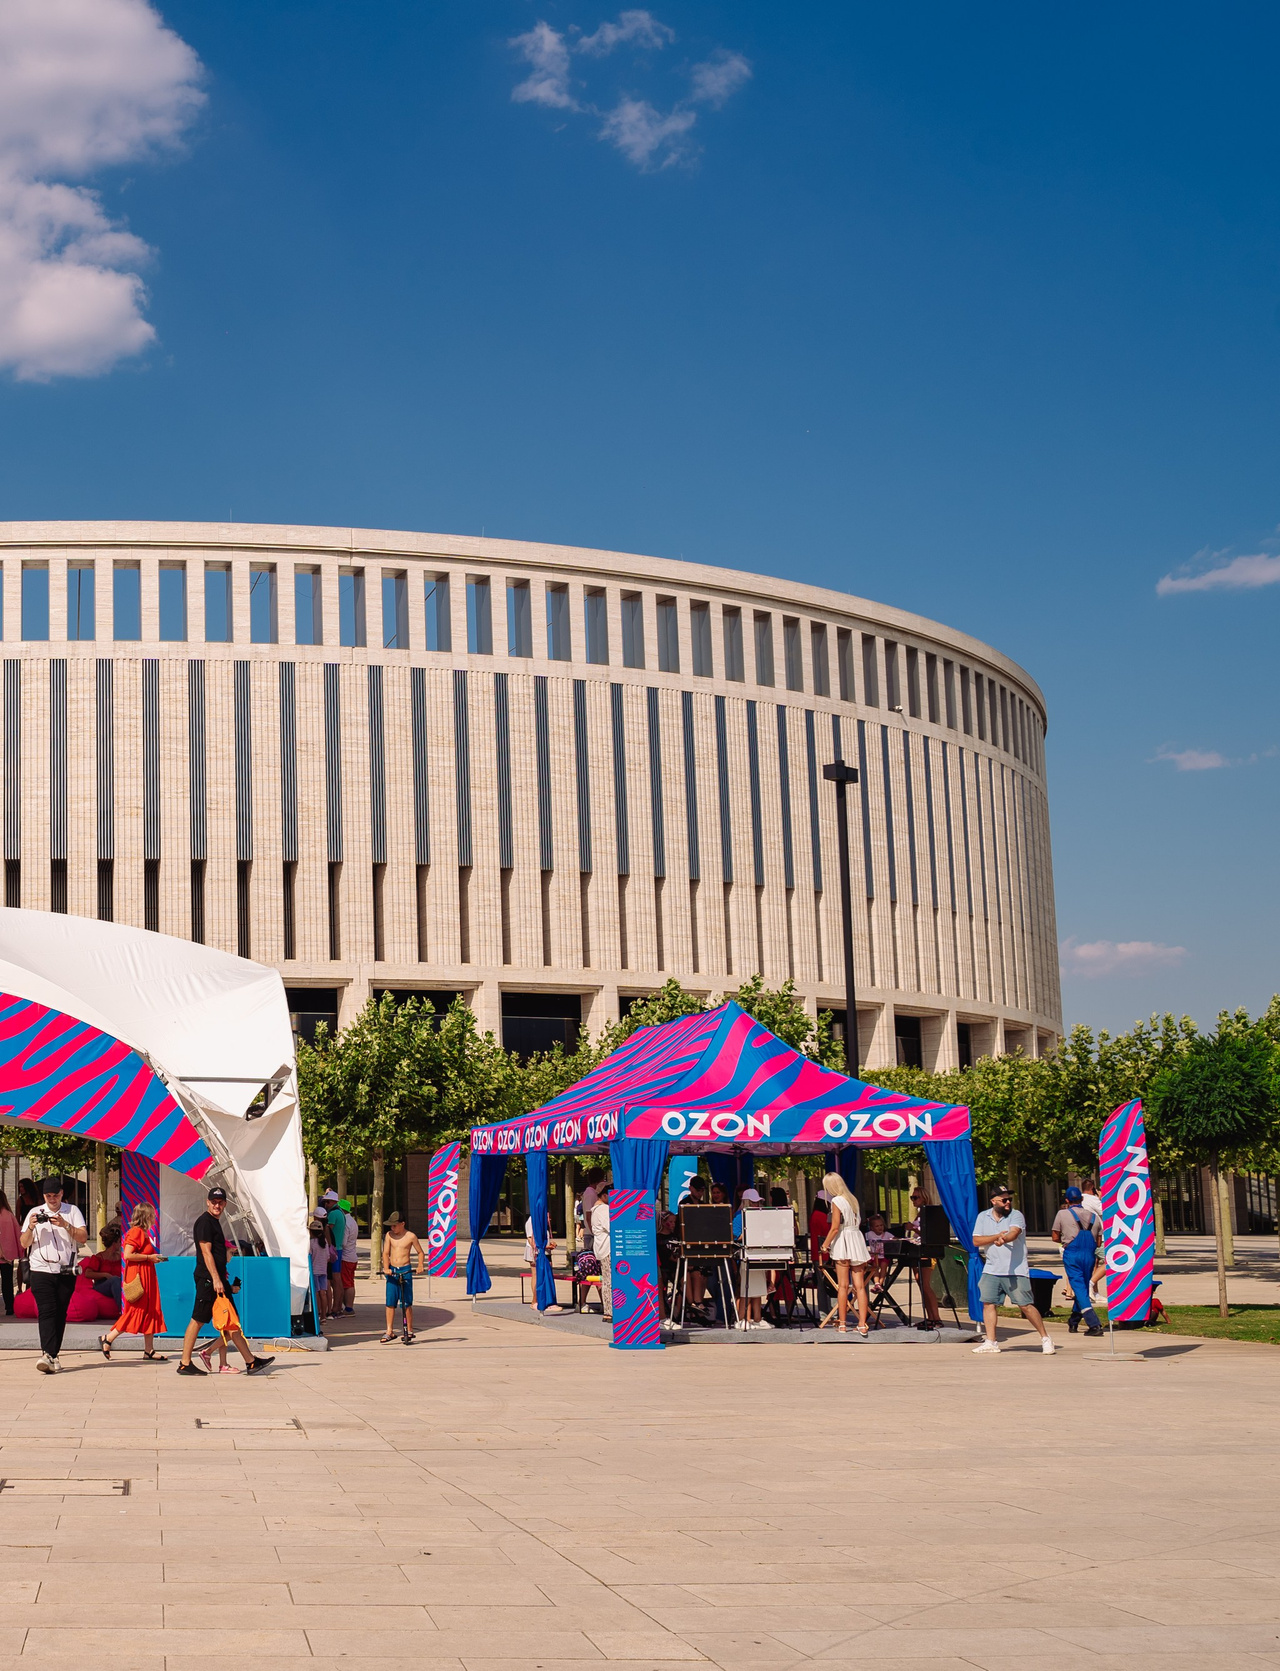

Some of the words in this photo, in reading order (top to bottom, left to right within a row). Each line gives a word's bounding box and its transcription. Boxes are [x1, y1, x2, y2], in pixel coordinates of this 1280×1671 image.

[472, 1130, 493, 1150] OZON
[497, 1129, 521, 1150] OZON
[525, 1124, 549, 1149] OZON
[553, 1118, 581, 1145] OZON
[586, 1111, 619, 1140] OZON
[661, 1111, 771, 1137] OZON
[823, 1113, 933, 1138] OZON
[429, 1170, 458, 1247] OZON
[1105, 1145, 1149, 1273] OZON
